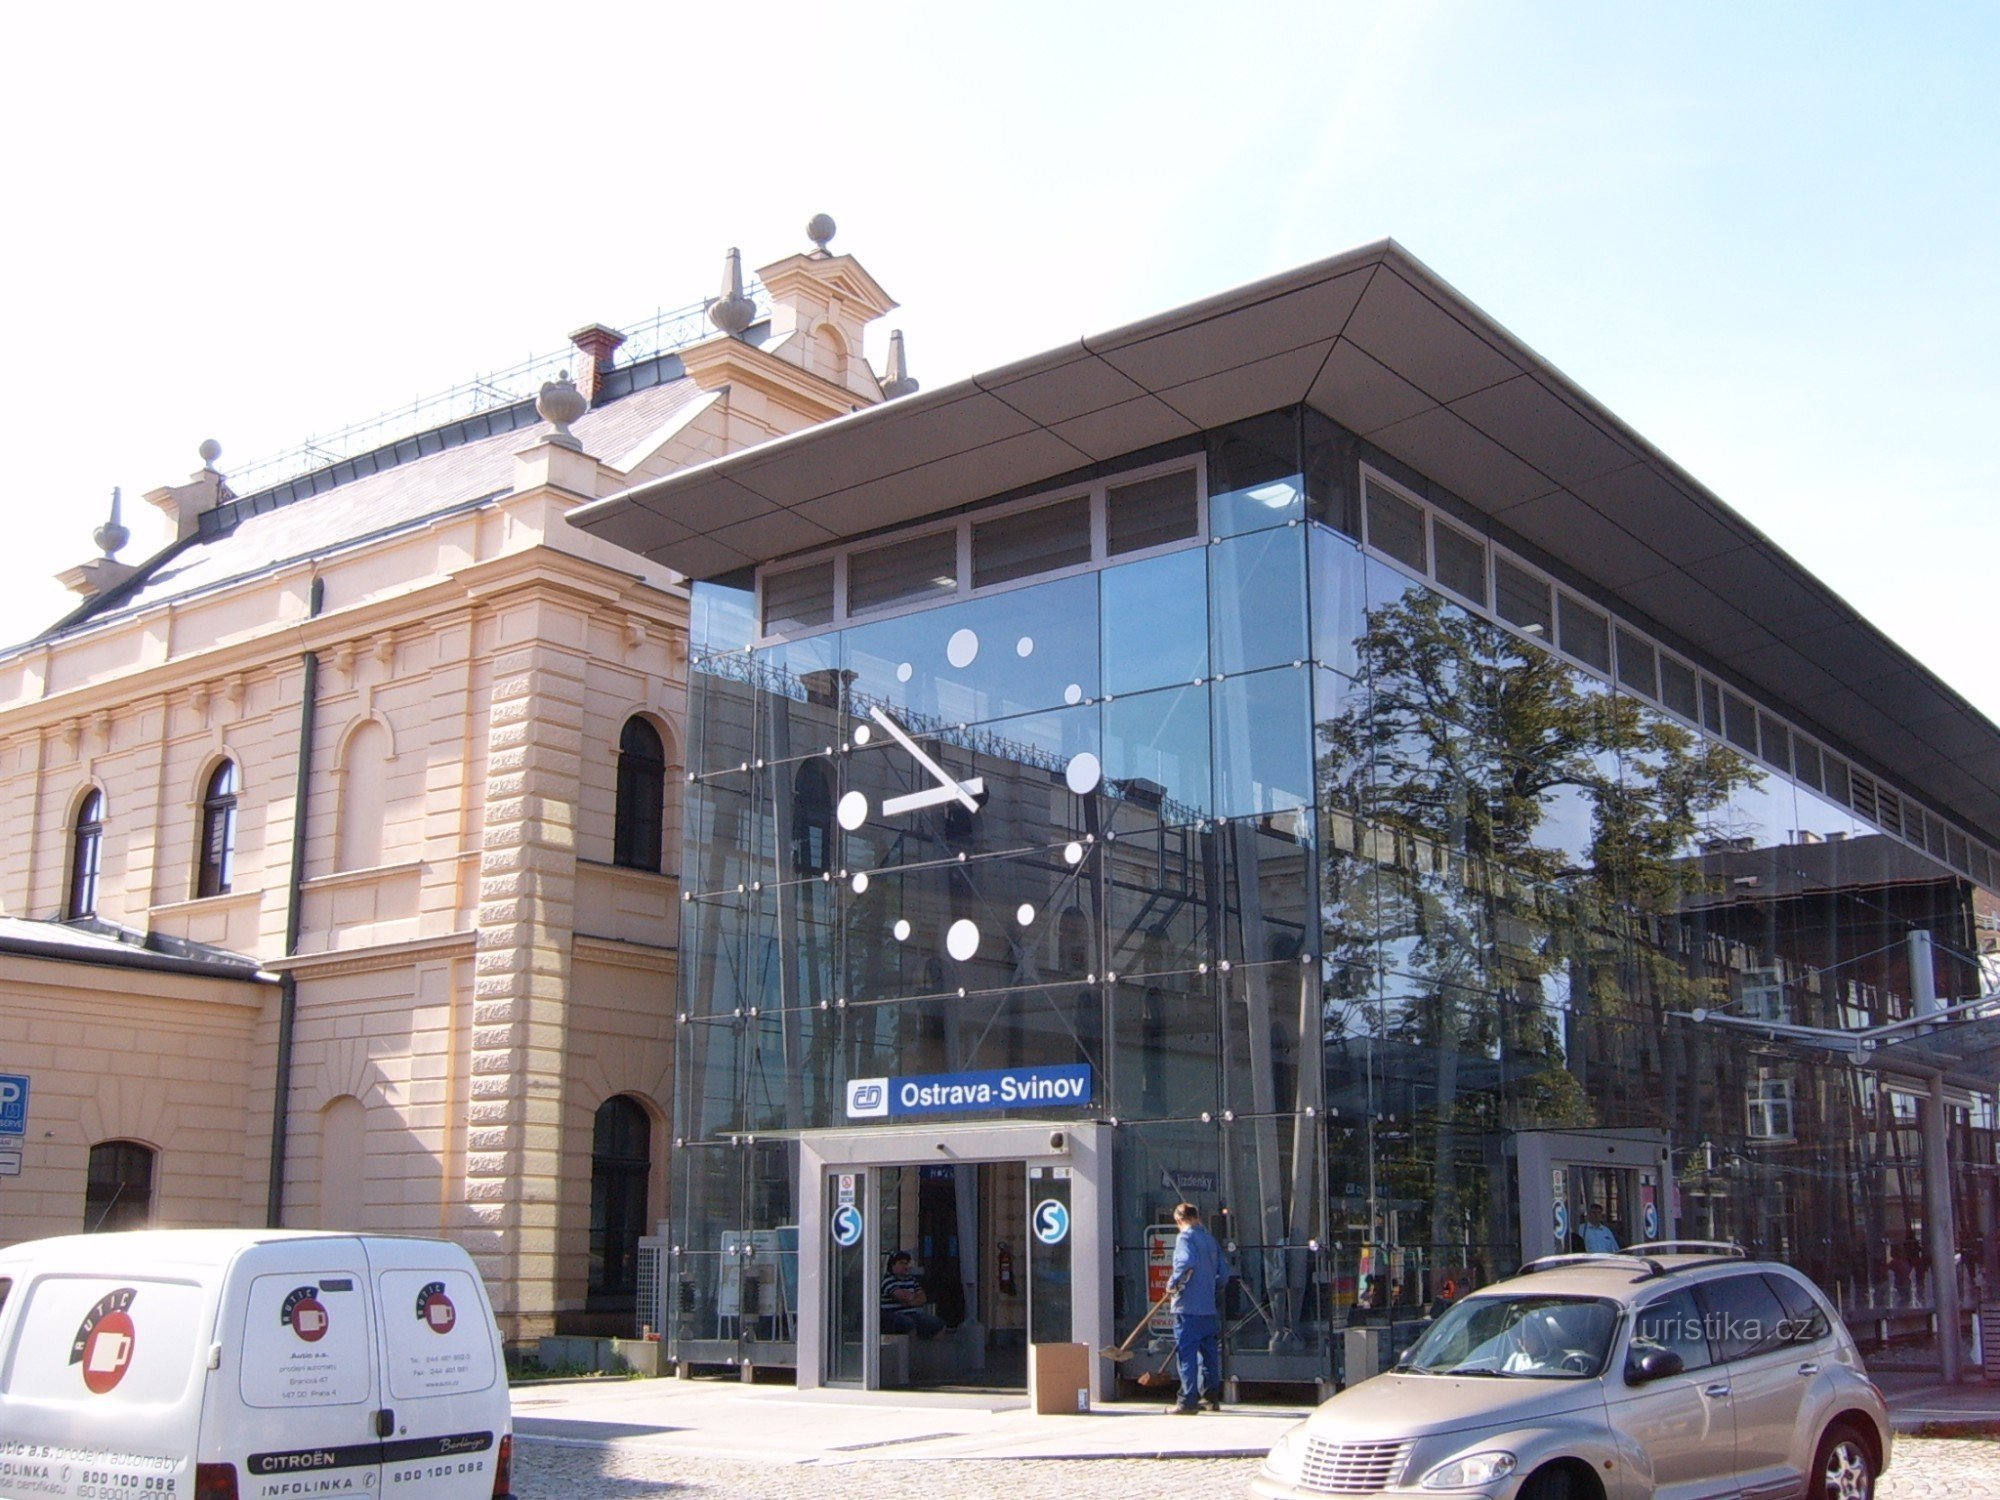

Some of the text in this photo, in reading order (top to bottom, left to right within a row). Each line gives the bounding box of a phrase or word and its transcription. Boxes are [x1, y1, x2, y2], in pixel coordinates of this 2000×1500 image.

[0, 1081, 20, 1116] P
[900, 1074, 1085, 1108] Ostrava-Svinov
[439, 1438, 485, 1452] Berlingo
[110, 1452, 180, 1474] automaty
[261, 1450, 335, 1471] CITROËN
[82, 1470, 108, 1485] 800
[113, 1473, 139, 1488] 100
[145, 1476, 176, 1491] 082
[393, 1461, 484, 1483] 800 100 082
[76, 1484, 96, 1498] ISO
[261, 1478, 353, 1496] INFOLINKA
